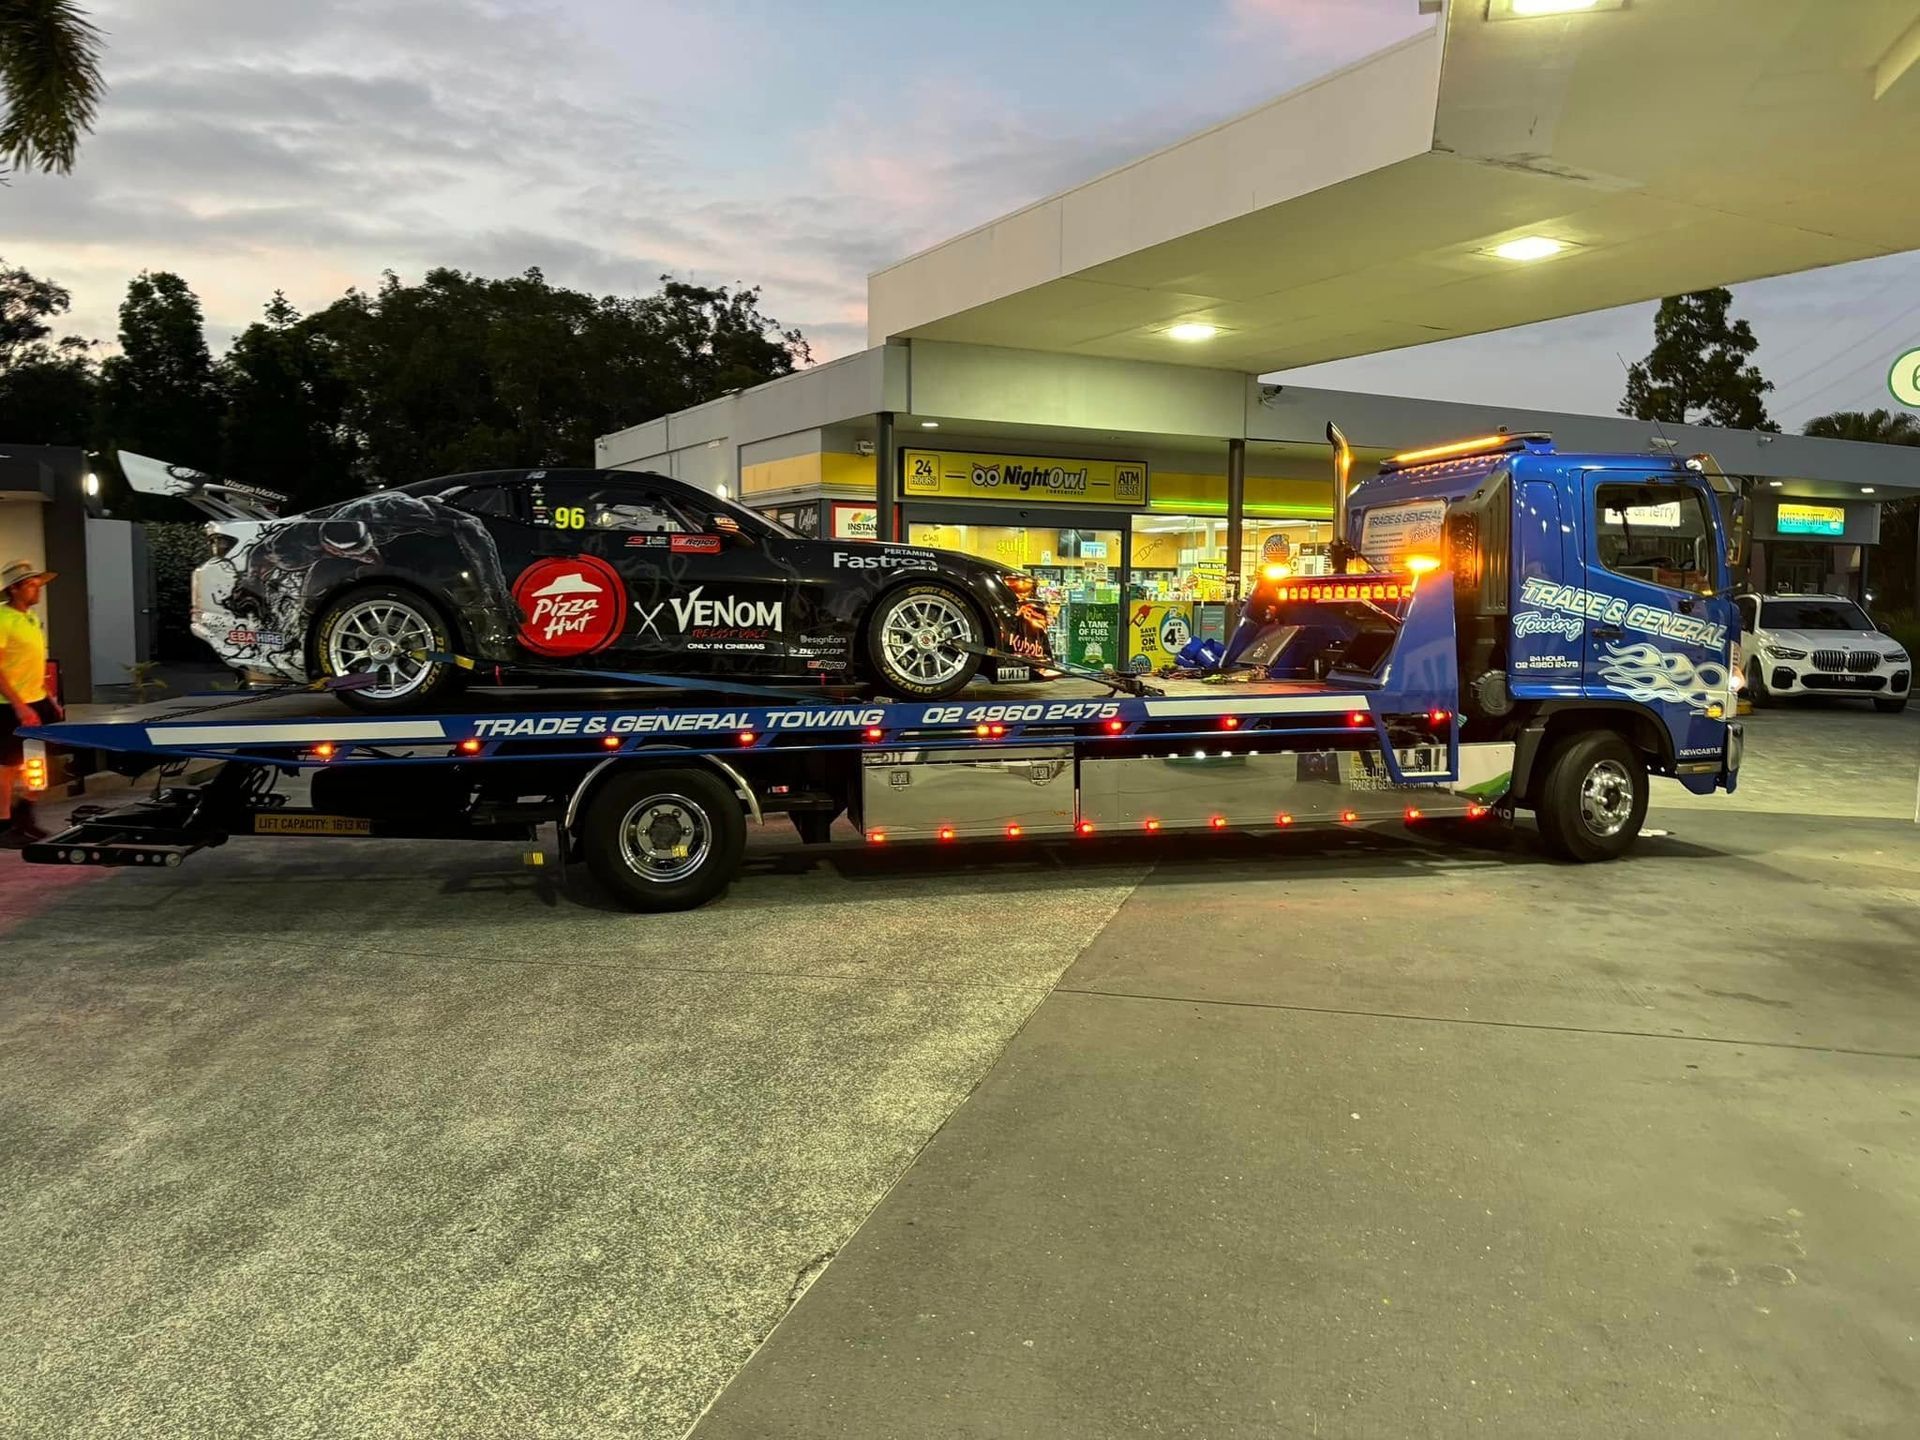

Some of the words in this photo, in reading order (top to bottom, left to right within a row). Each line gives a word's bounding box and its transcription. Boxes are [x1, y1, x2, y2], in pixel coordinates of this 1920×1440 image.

[915, 460, 932, 475] 24
[911, 475, 936, 486] HOURS
[1003, 466, 1087, 491] NightOwl
[1118, 471, 1139, 484] ATM
[1118, 484, 1139, 496] HERE
[555, 507, 585, 529] 96
[799, 507, 818, 531] Coffee
[848, 523, 877, 531] INSTAN
[684, 538, 719, 547] Repco
[833, 552, 938, 568] Fastron
[884, 548, 936, 558] PERTAMINA
[532, 595, 600, 625] Pizza
[668, 585, 783, 633] VENOM
[1520, 577, 1610, 620] TRADE
[1603, 599, 1628, 626] &
[1624, 603, 1728, 651] GENERAL
[543, 613, 597, 640] Hut
[1513, 611, 1584, 642] Towing
[229, 632, 255, 642] EBA
[256, 633, 282, 644] HIRE
[1142, 638, 1156, 646] ON
[1163, 628, 1177, 646] 4
[798, 647, 846, 655] DUNLOP
[1009, 633, 1043, 657] Kubota
[999, 668, 1027, 680] UNIT
[472, 716, 583, 737] TRADE
[583, 716, 607, 734] &
[611, 713, 754, 733] GENERAL
[766, 709, 885, 729] TOWING
[922, 707, 964, 724] 02
[965, 705, 1043, 722] 4960
[1045, 703, 1120, 720] 2475
[1679, 746, 1722, 756] NEWCASTLE
[258, 818, 278, 829] LIFT
[281, 818, 329, 830] CAPACITY:
